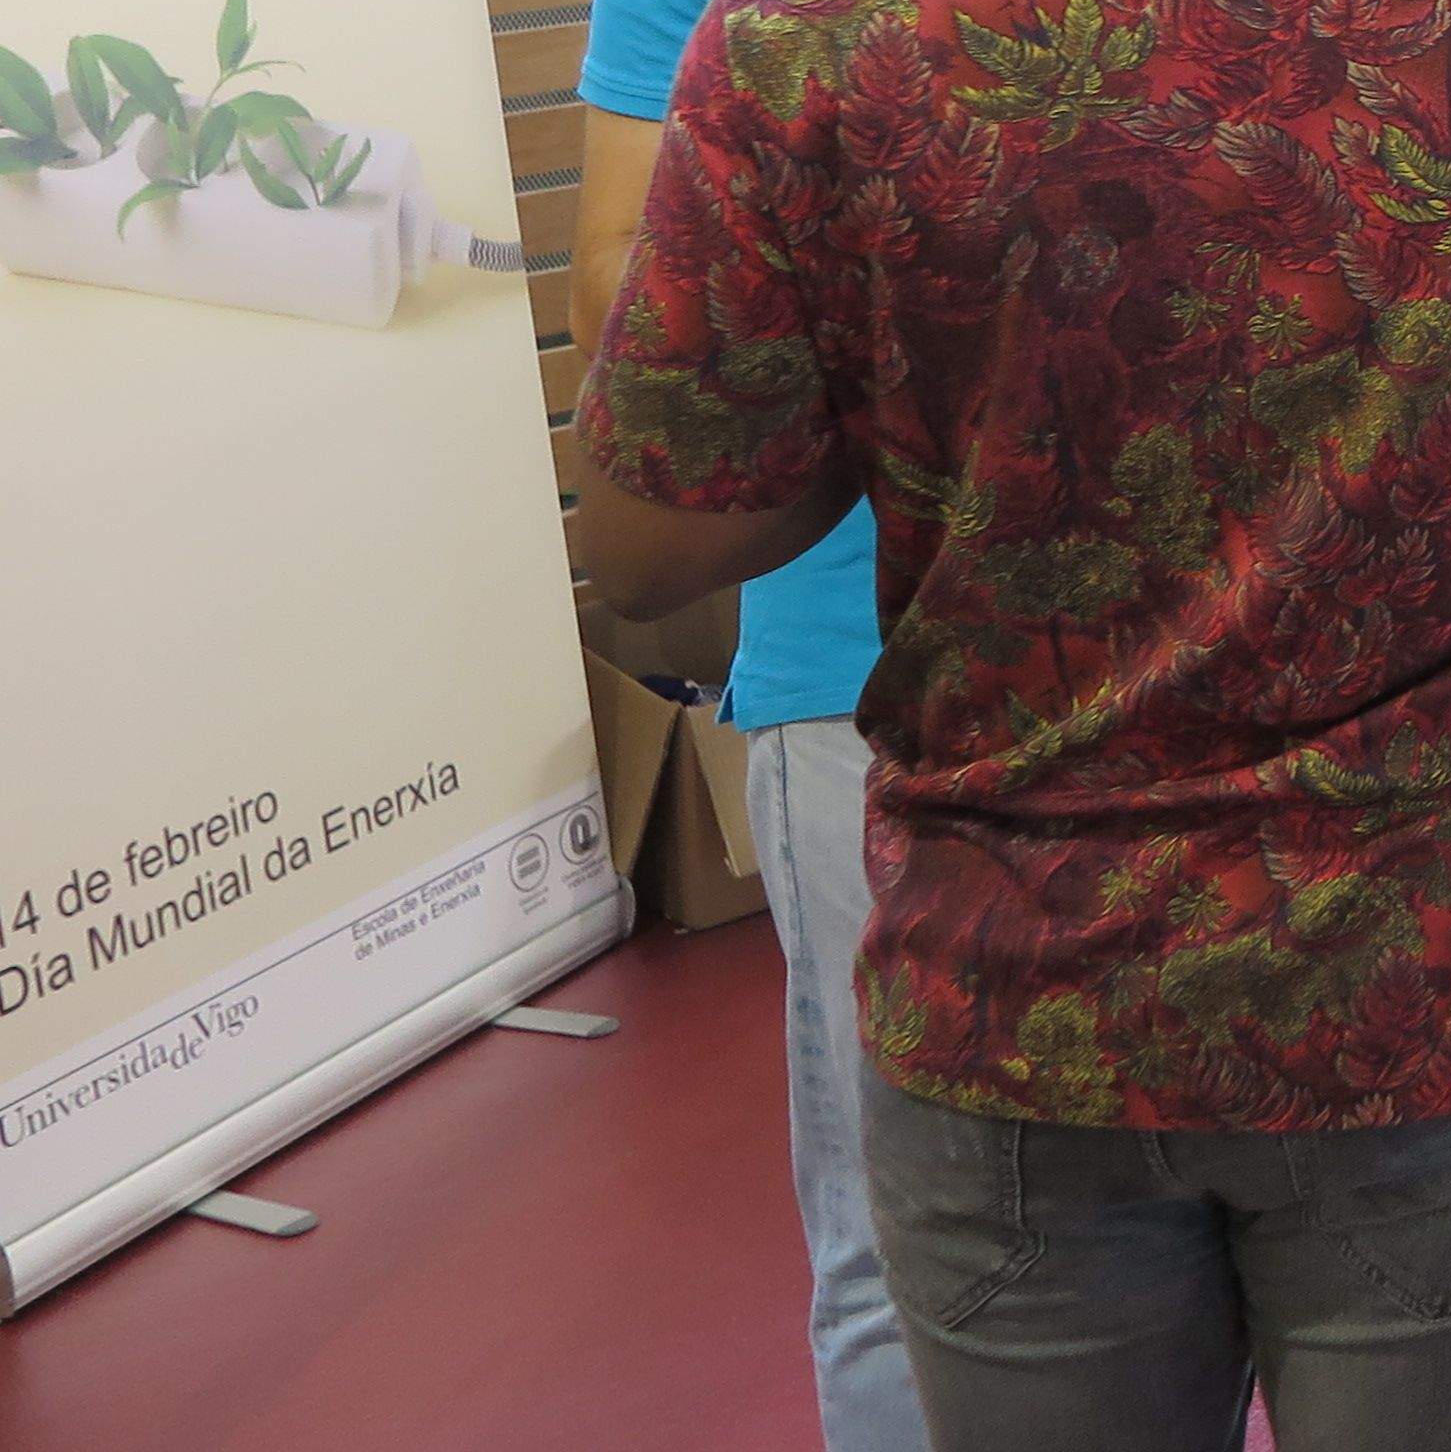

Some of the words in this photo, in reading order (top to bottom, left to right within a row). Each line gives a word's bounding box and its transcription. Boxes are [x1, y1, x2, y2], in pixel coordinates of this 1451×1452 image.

[0, 952, 76, 1017] Día
[86, 855, 252, 972] Mundial
[263, 836, 312, 882] da
[321, 762, 461, 853] Enerxía
[56, 869, 112, 917] de
[124, 791, 279, 886] febreiro
